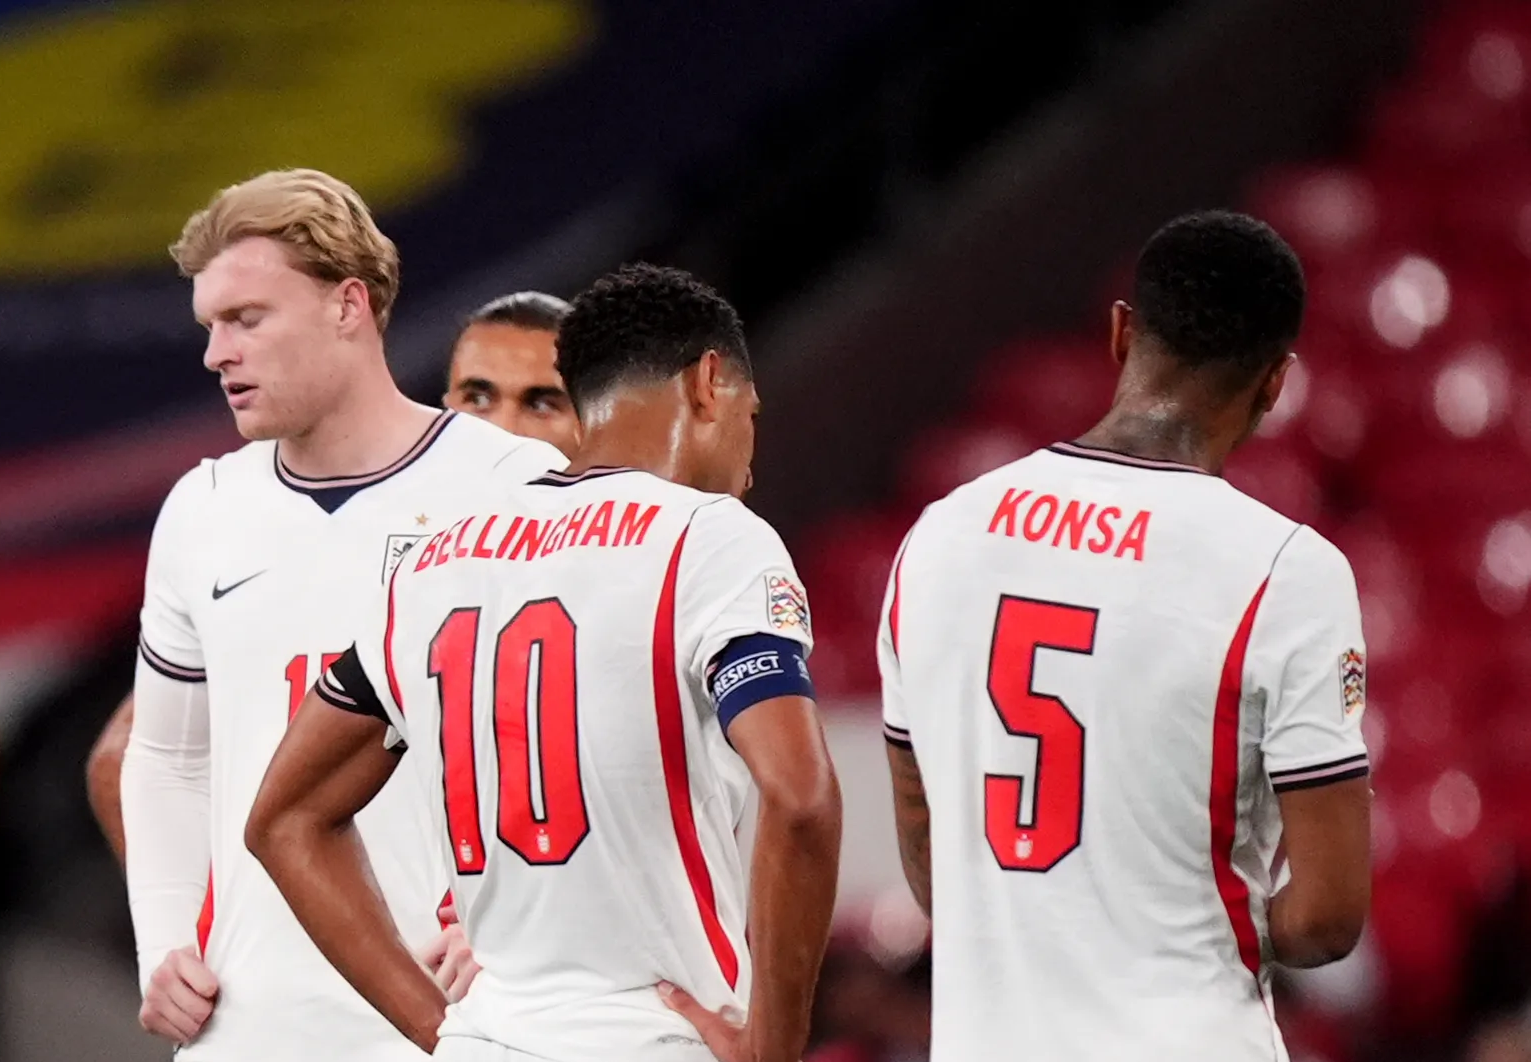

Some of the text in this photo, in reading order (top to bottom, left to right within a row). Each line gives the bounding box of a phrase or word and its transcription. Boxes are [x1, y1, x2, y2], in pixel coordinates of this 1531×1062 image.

[414, 499, 662, 573] BELLINGHAM
[987, 487, 1152, 562] KONSA
[285, 652, 345, 725] 1
[713, 655, 780, 697] RESPECT
[427, 596, 591, 876] 10
[984, 593, 1099, 874] 5
